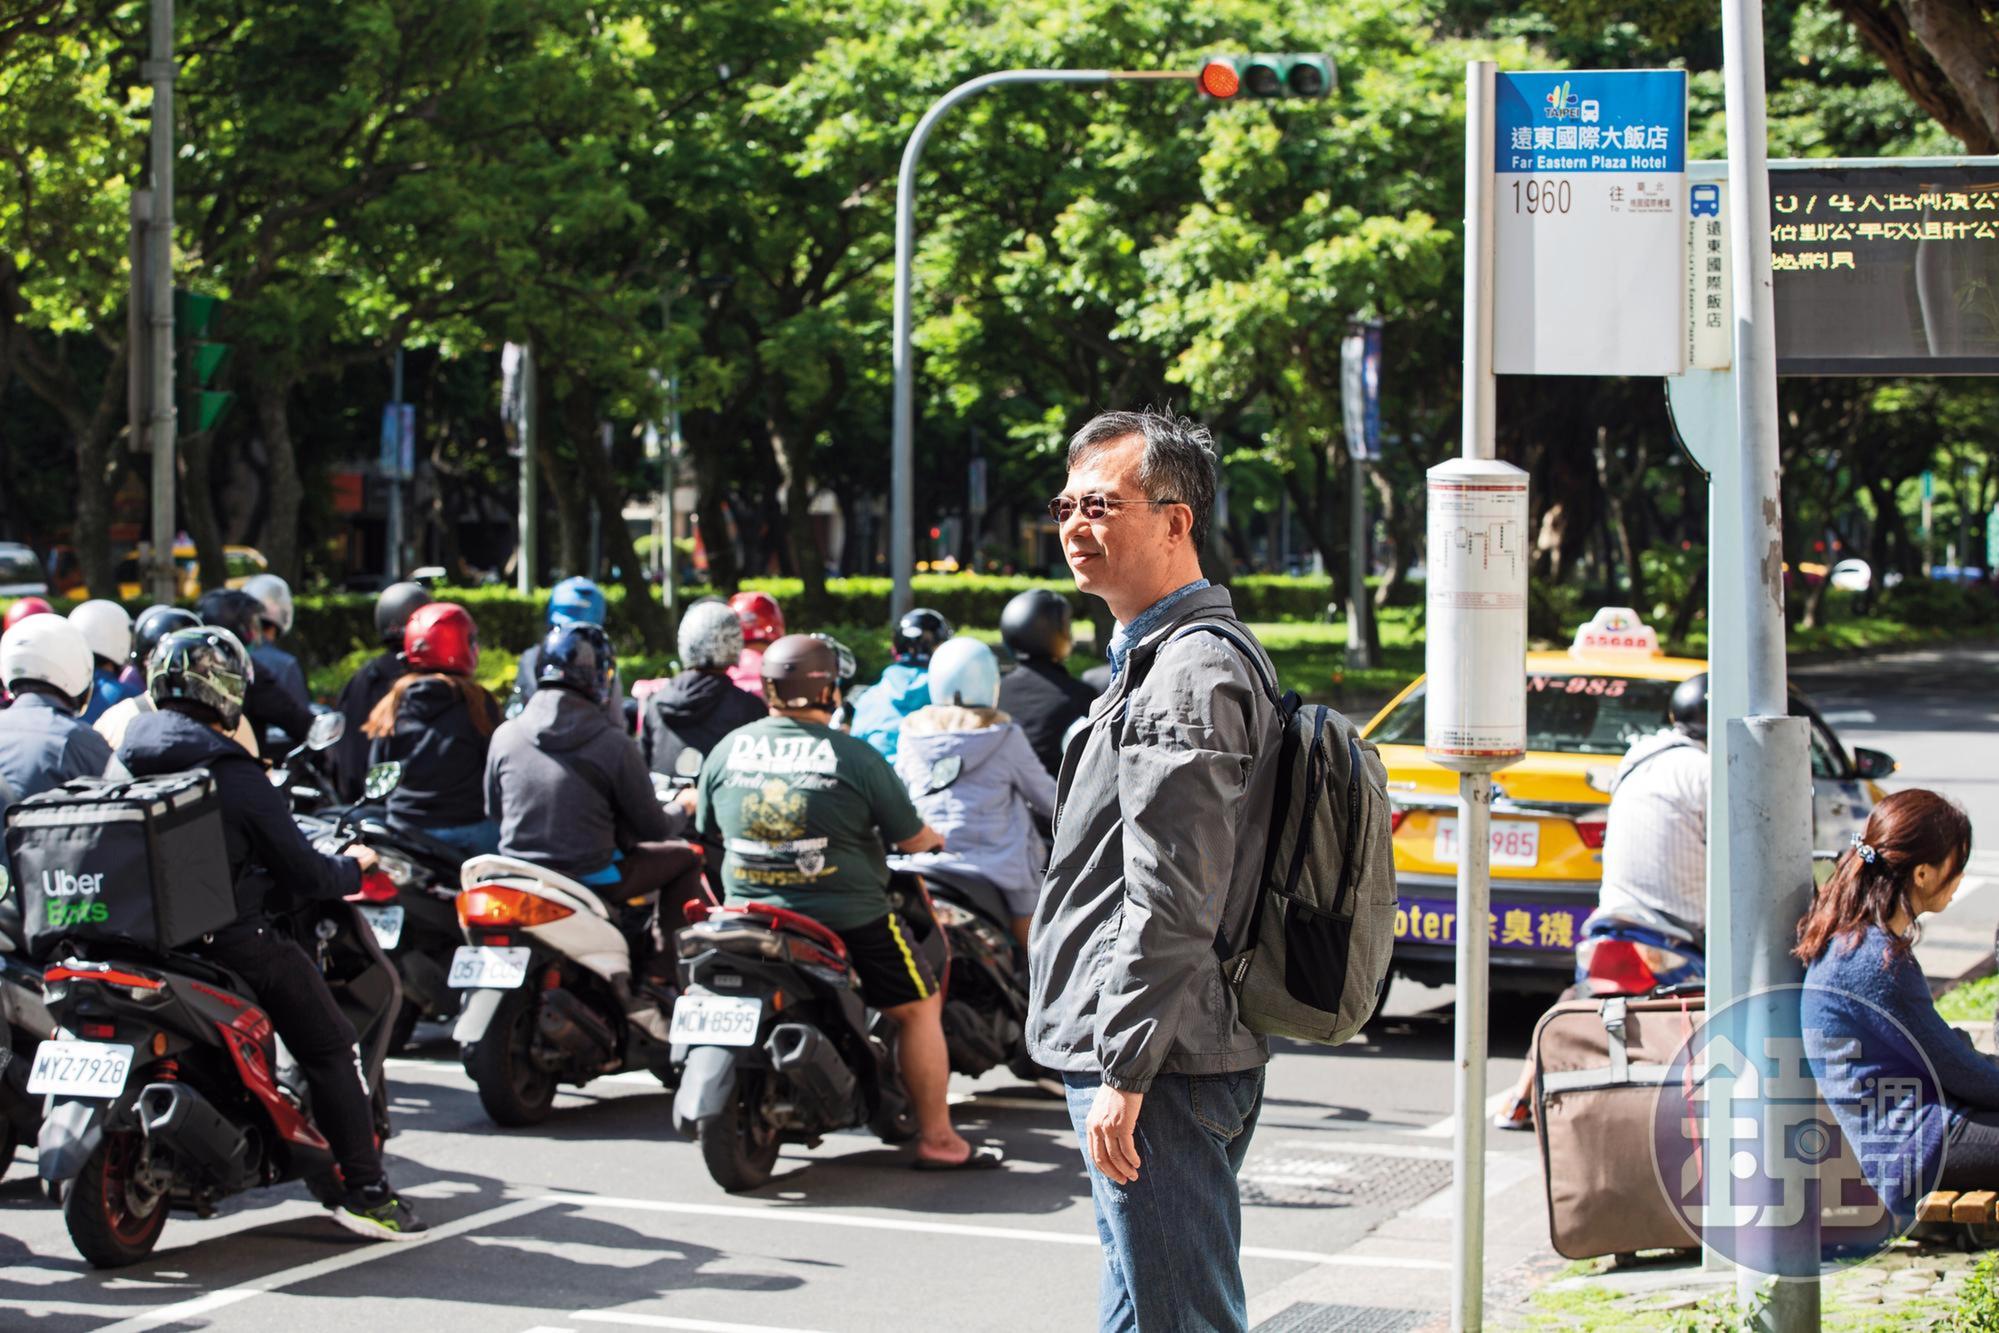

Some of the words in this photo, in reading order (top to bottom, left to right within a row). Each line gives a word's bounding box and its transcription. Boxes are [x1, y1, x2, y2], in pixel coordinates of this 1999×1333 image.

[1544, 107, 1580, 118] TAIPEI
[1511, 125, 1669, 150] 遠東國際大飯店
[1512, 156, 1534, 169] Far
[1537, 156, 1587, 169] Eastern
[1591, 155, 1627, 169] Plaza
[1631, 155, 1667, 169] Hotel
[1512, 179, 1571, 214] 1960
[1706, 220, 1722, 328] 遠東國際飯店
[42, 869, 104, 897] Uber
[47, 898, 109, 926] Eats
